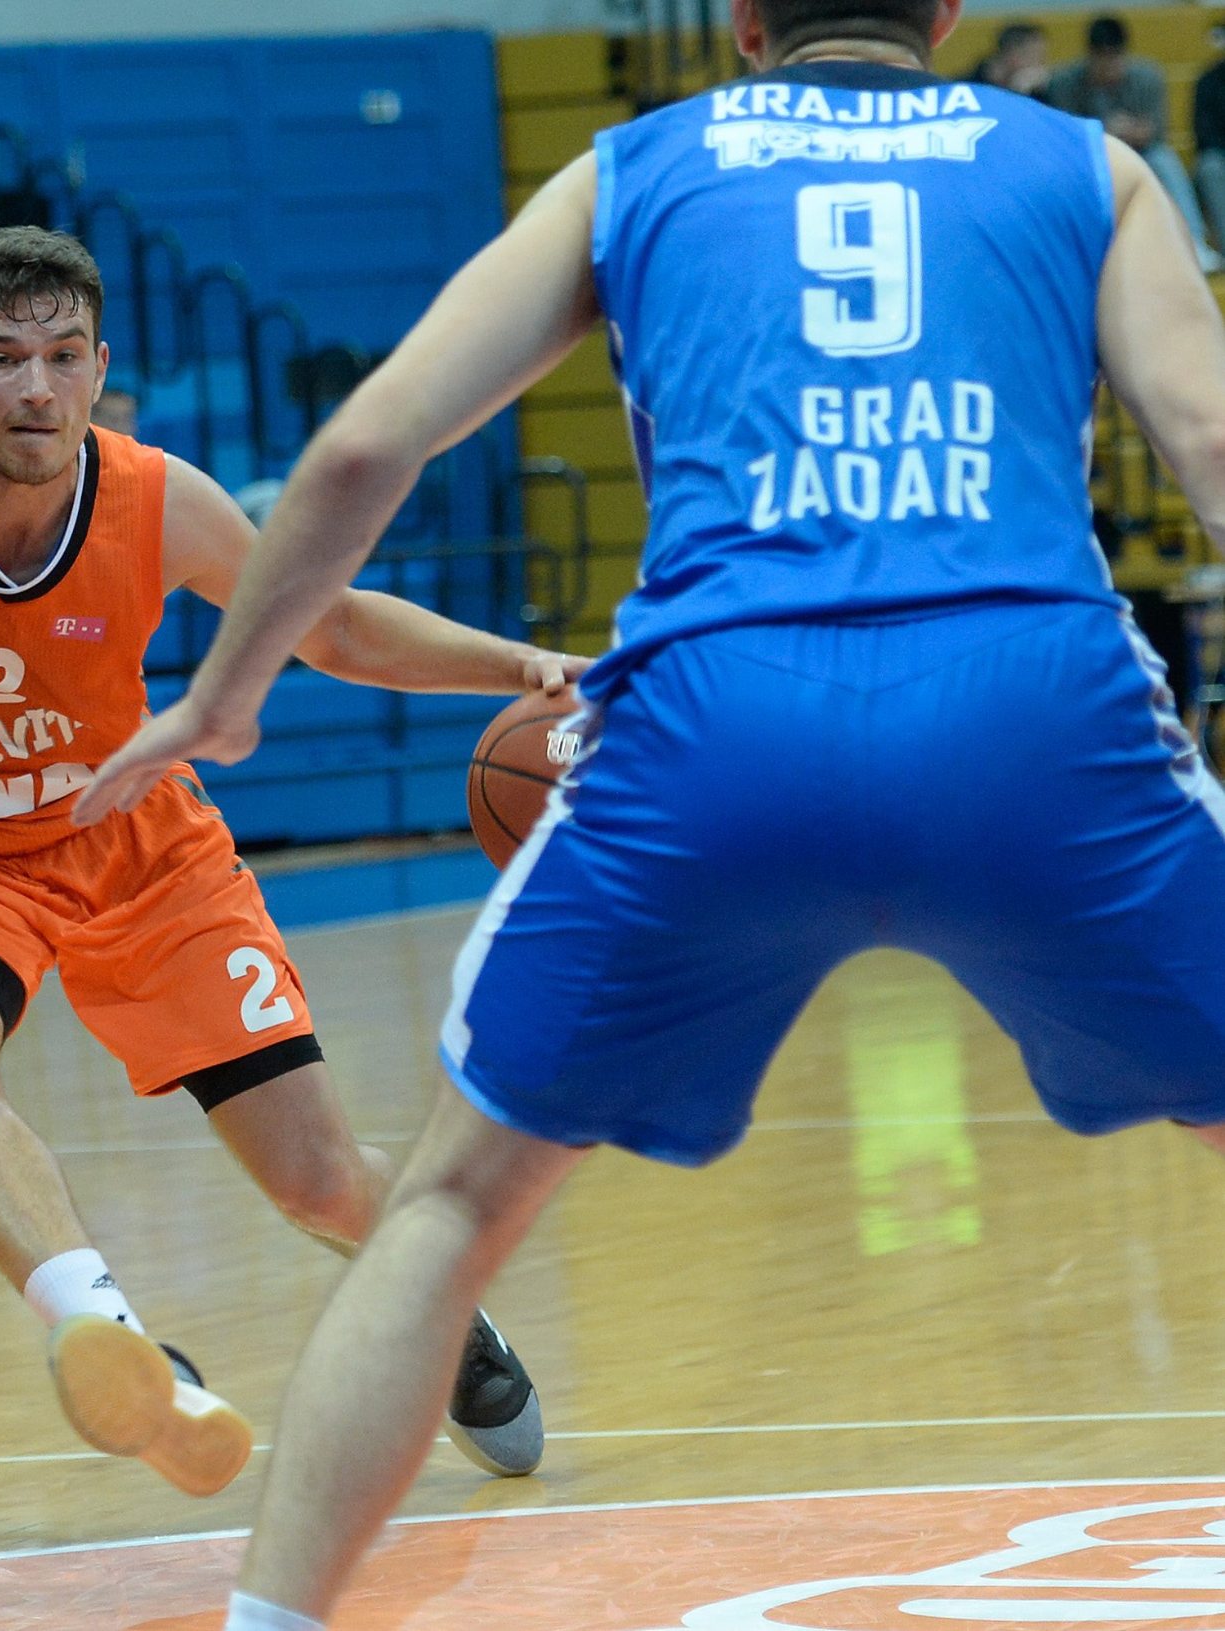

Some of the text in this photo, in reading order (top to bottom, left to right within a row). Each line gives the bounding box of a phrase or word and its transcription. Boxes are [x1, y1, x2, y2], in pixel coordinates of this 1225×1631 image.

[712, 84, 982, 123] KRAJINA
[796, 182, 923, 357] 9
[802, 380, 995, 448] GRAD
[748, 446, 992, 532] ZADAR
[226, 946, 294, 1034] 2
